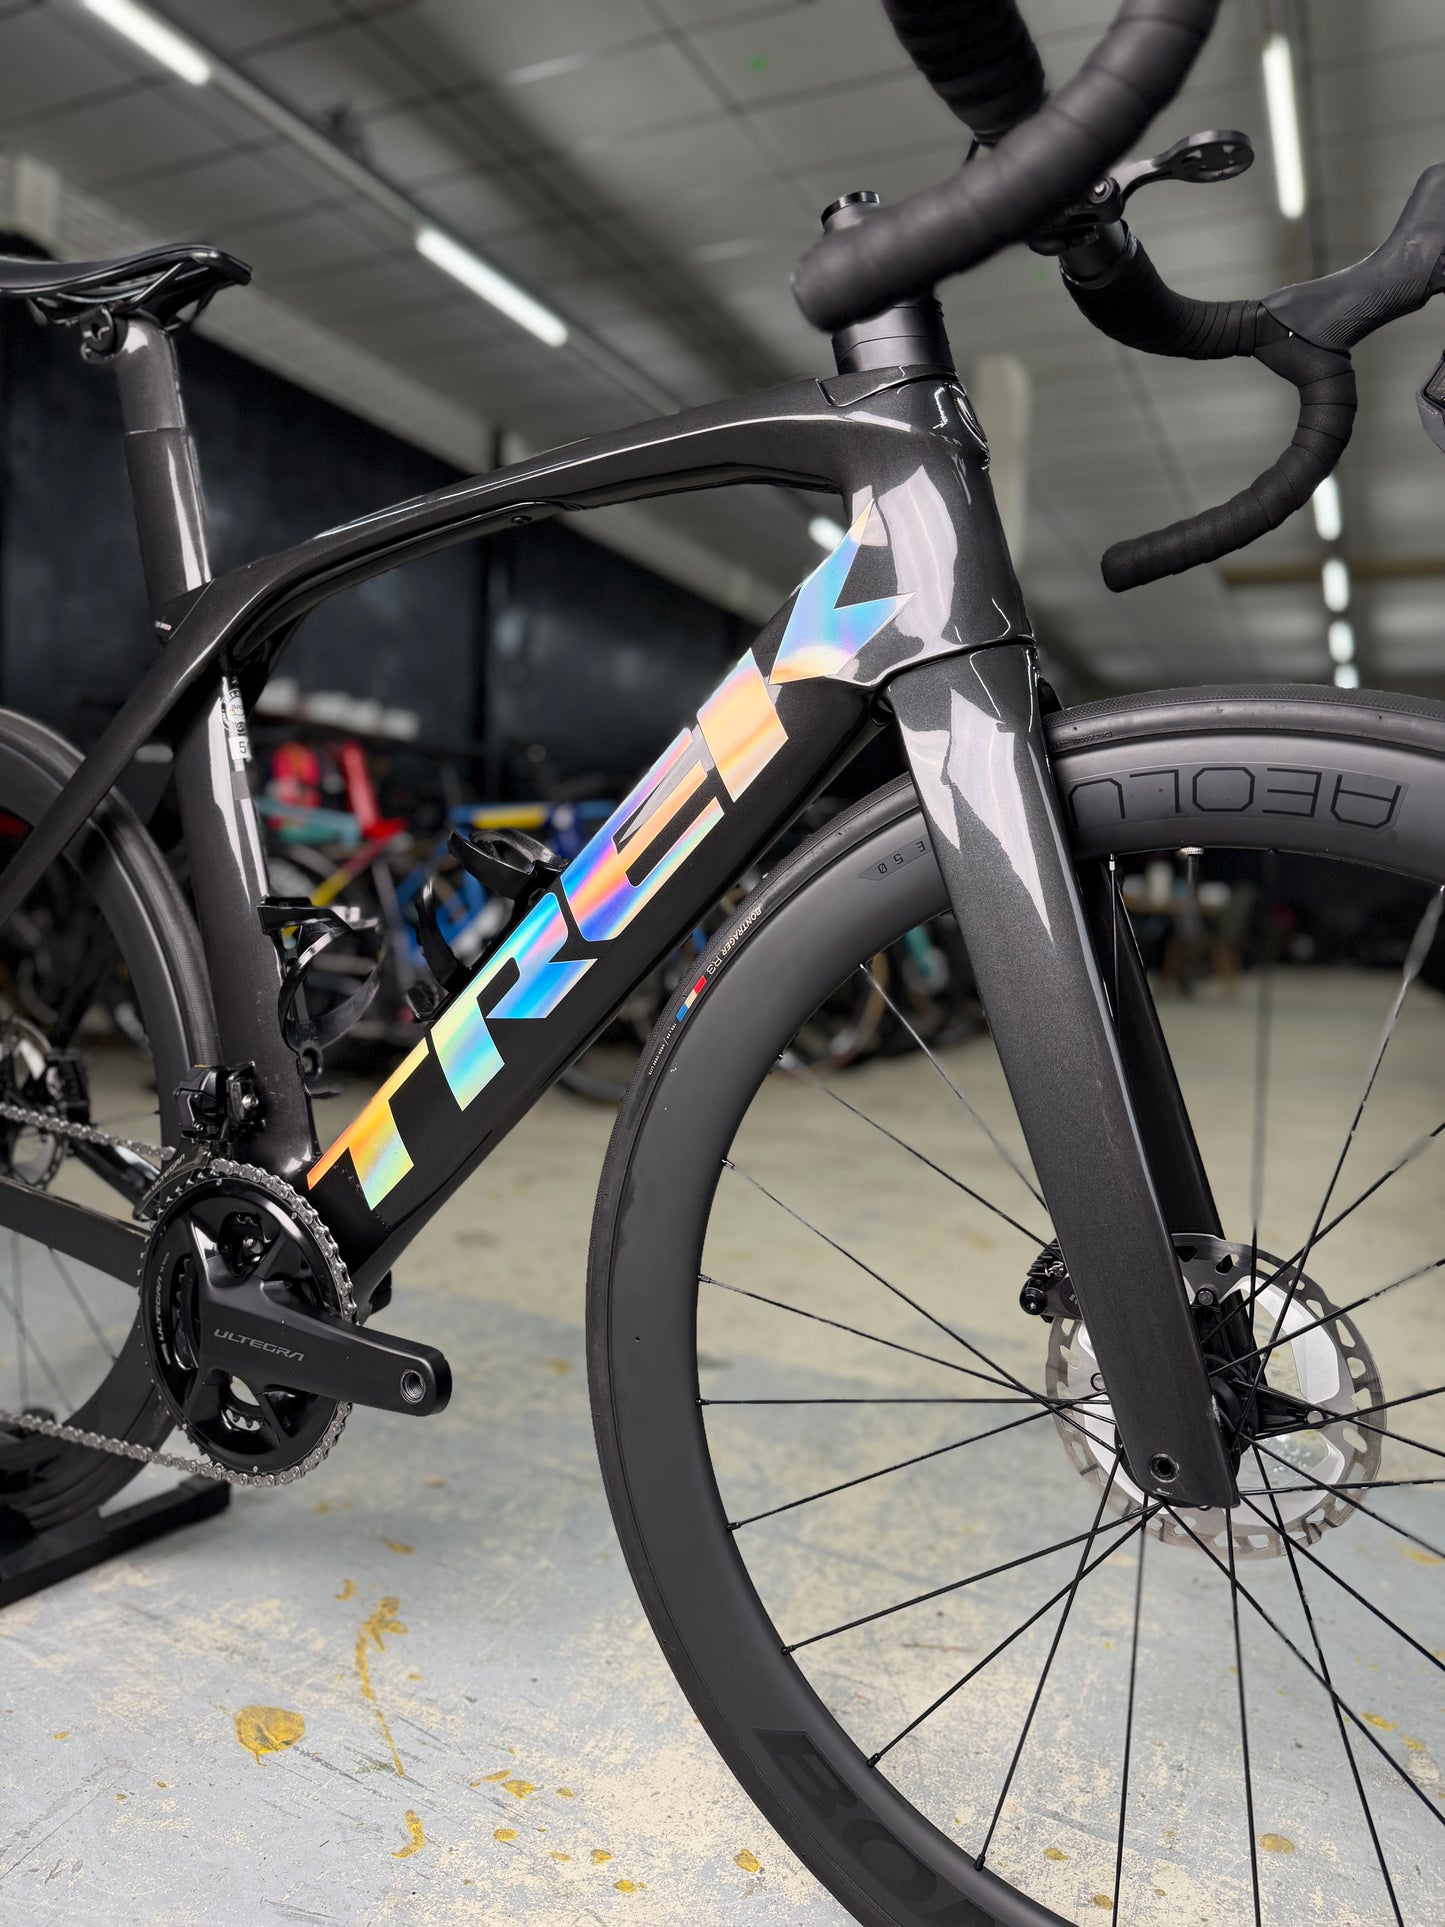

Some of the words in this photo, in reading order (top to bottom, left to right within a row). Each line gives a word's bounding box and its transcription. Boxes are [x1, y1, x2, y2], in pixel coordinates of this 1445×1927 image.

[307, 500, 916, 1210] TREK
[877, 853, 904, 874] 50
[721, 906, 762, 956] BONTRAGER
[706, 956, 723, 976] R3
[151, 1153, 186, 1191] ULTEGRA
[151, 1275, 165, 1342] ULTEGRA
[213, 1327, 306, 1363] ULTEGRA
